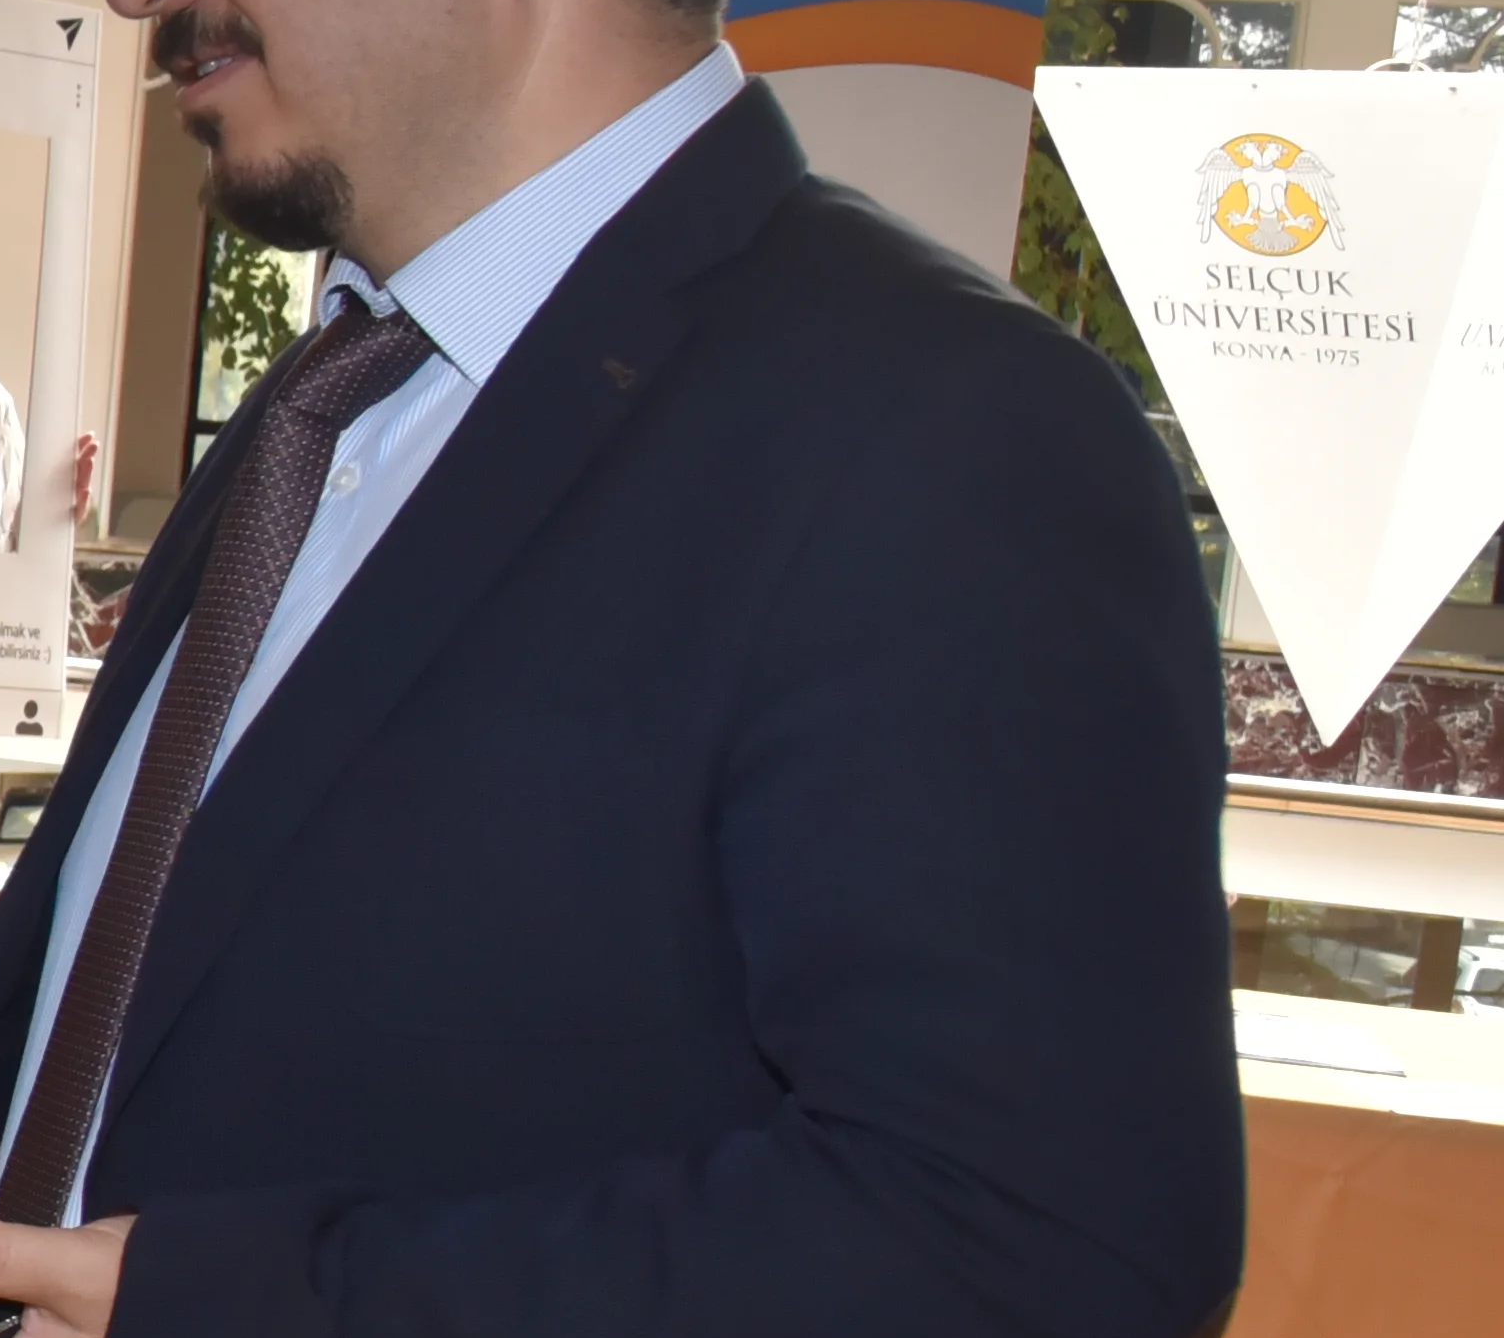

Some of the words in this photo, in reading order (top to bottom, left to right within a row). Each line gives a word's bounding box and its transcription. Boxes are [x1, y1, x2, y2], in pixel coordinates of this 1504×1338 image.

[1205, 263, 1355, 301] SELÇUK
[1152, 294, 1420, 344] ÜNİVERSİTESİ
[1212, 340, 1295, 363] KONYA
[1315, 347, 1361, 368] 1975
